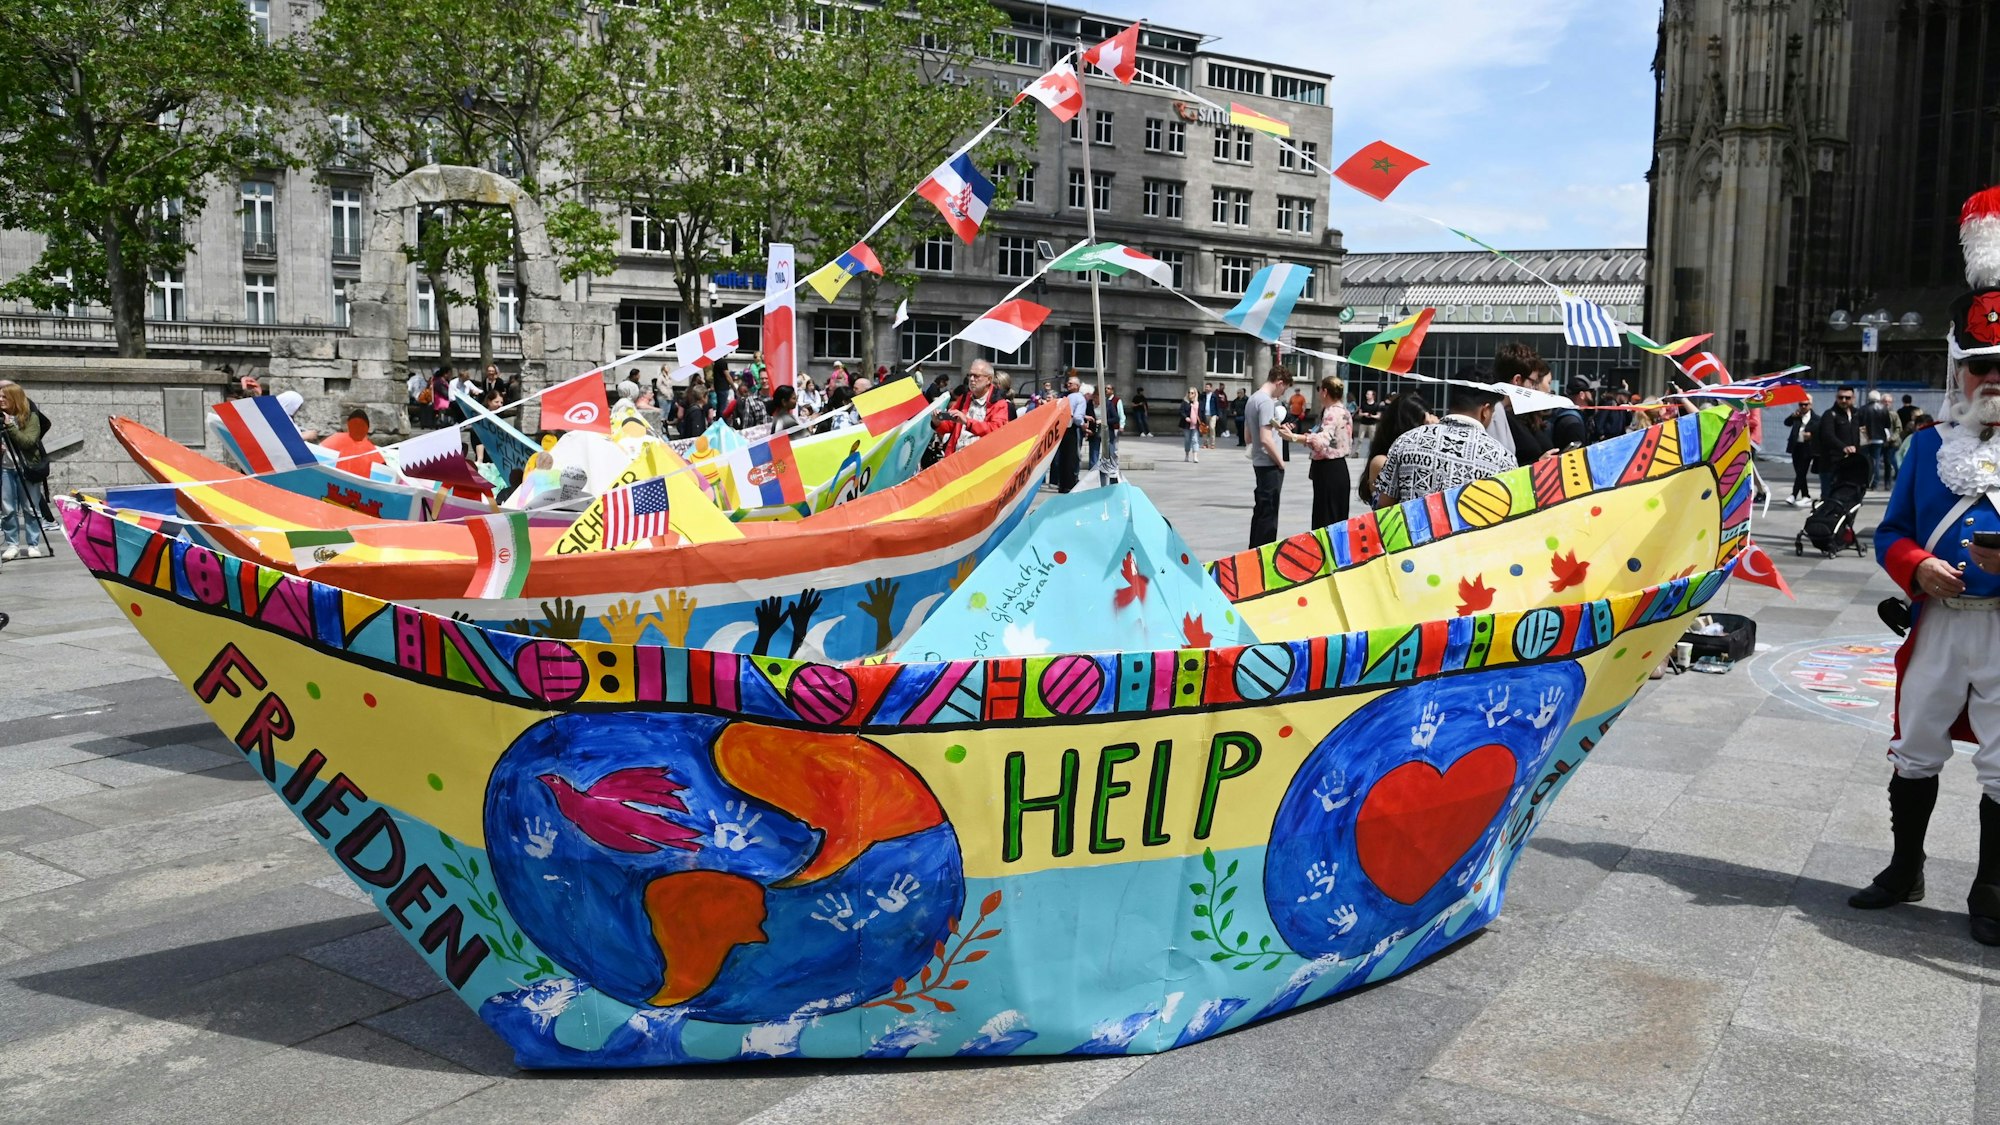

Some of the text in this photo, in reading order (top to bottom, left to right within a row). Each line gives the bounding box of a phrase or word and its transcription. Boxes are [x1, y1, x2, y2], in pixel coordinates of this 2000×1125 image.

[1199, 107, 1231, 127] SATU
[973, 631, 995, 658] sch
[193, 641, 491, 990] FRIEDEN
[1002, 731, 1263, 864] HELP
